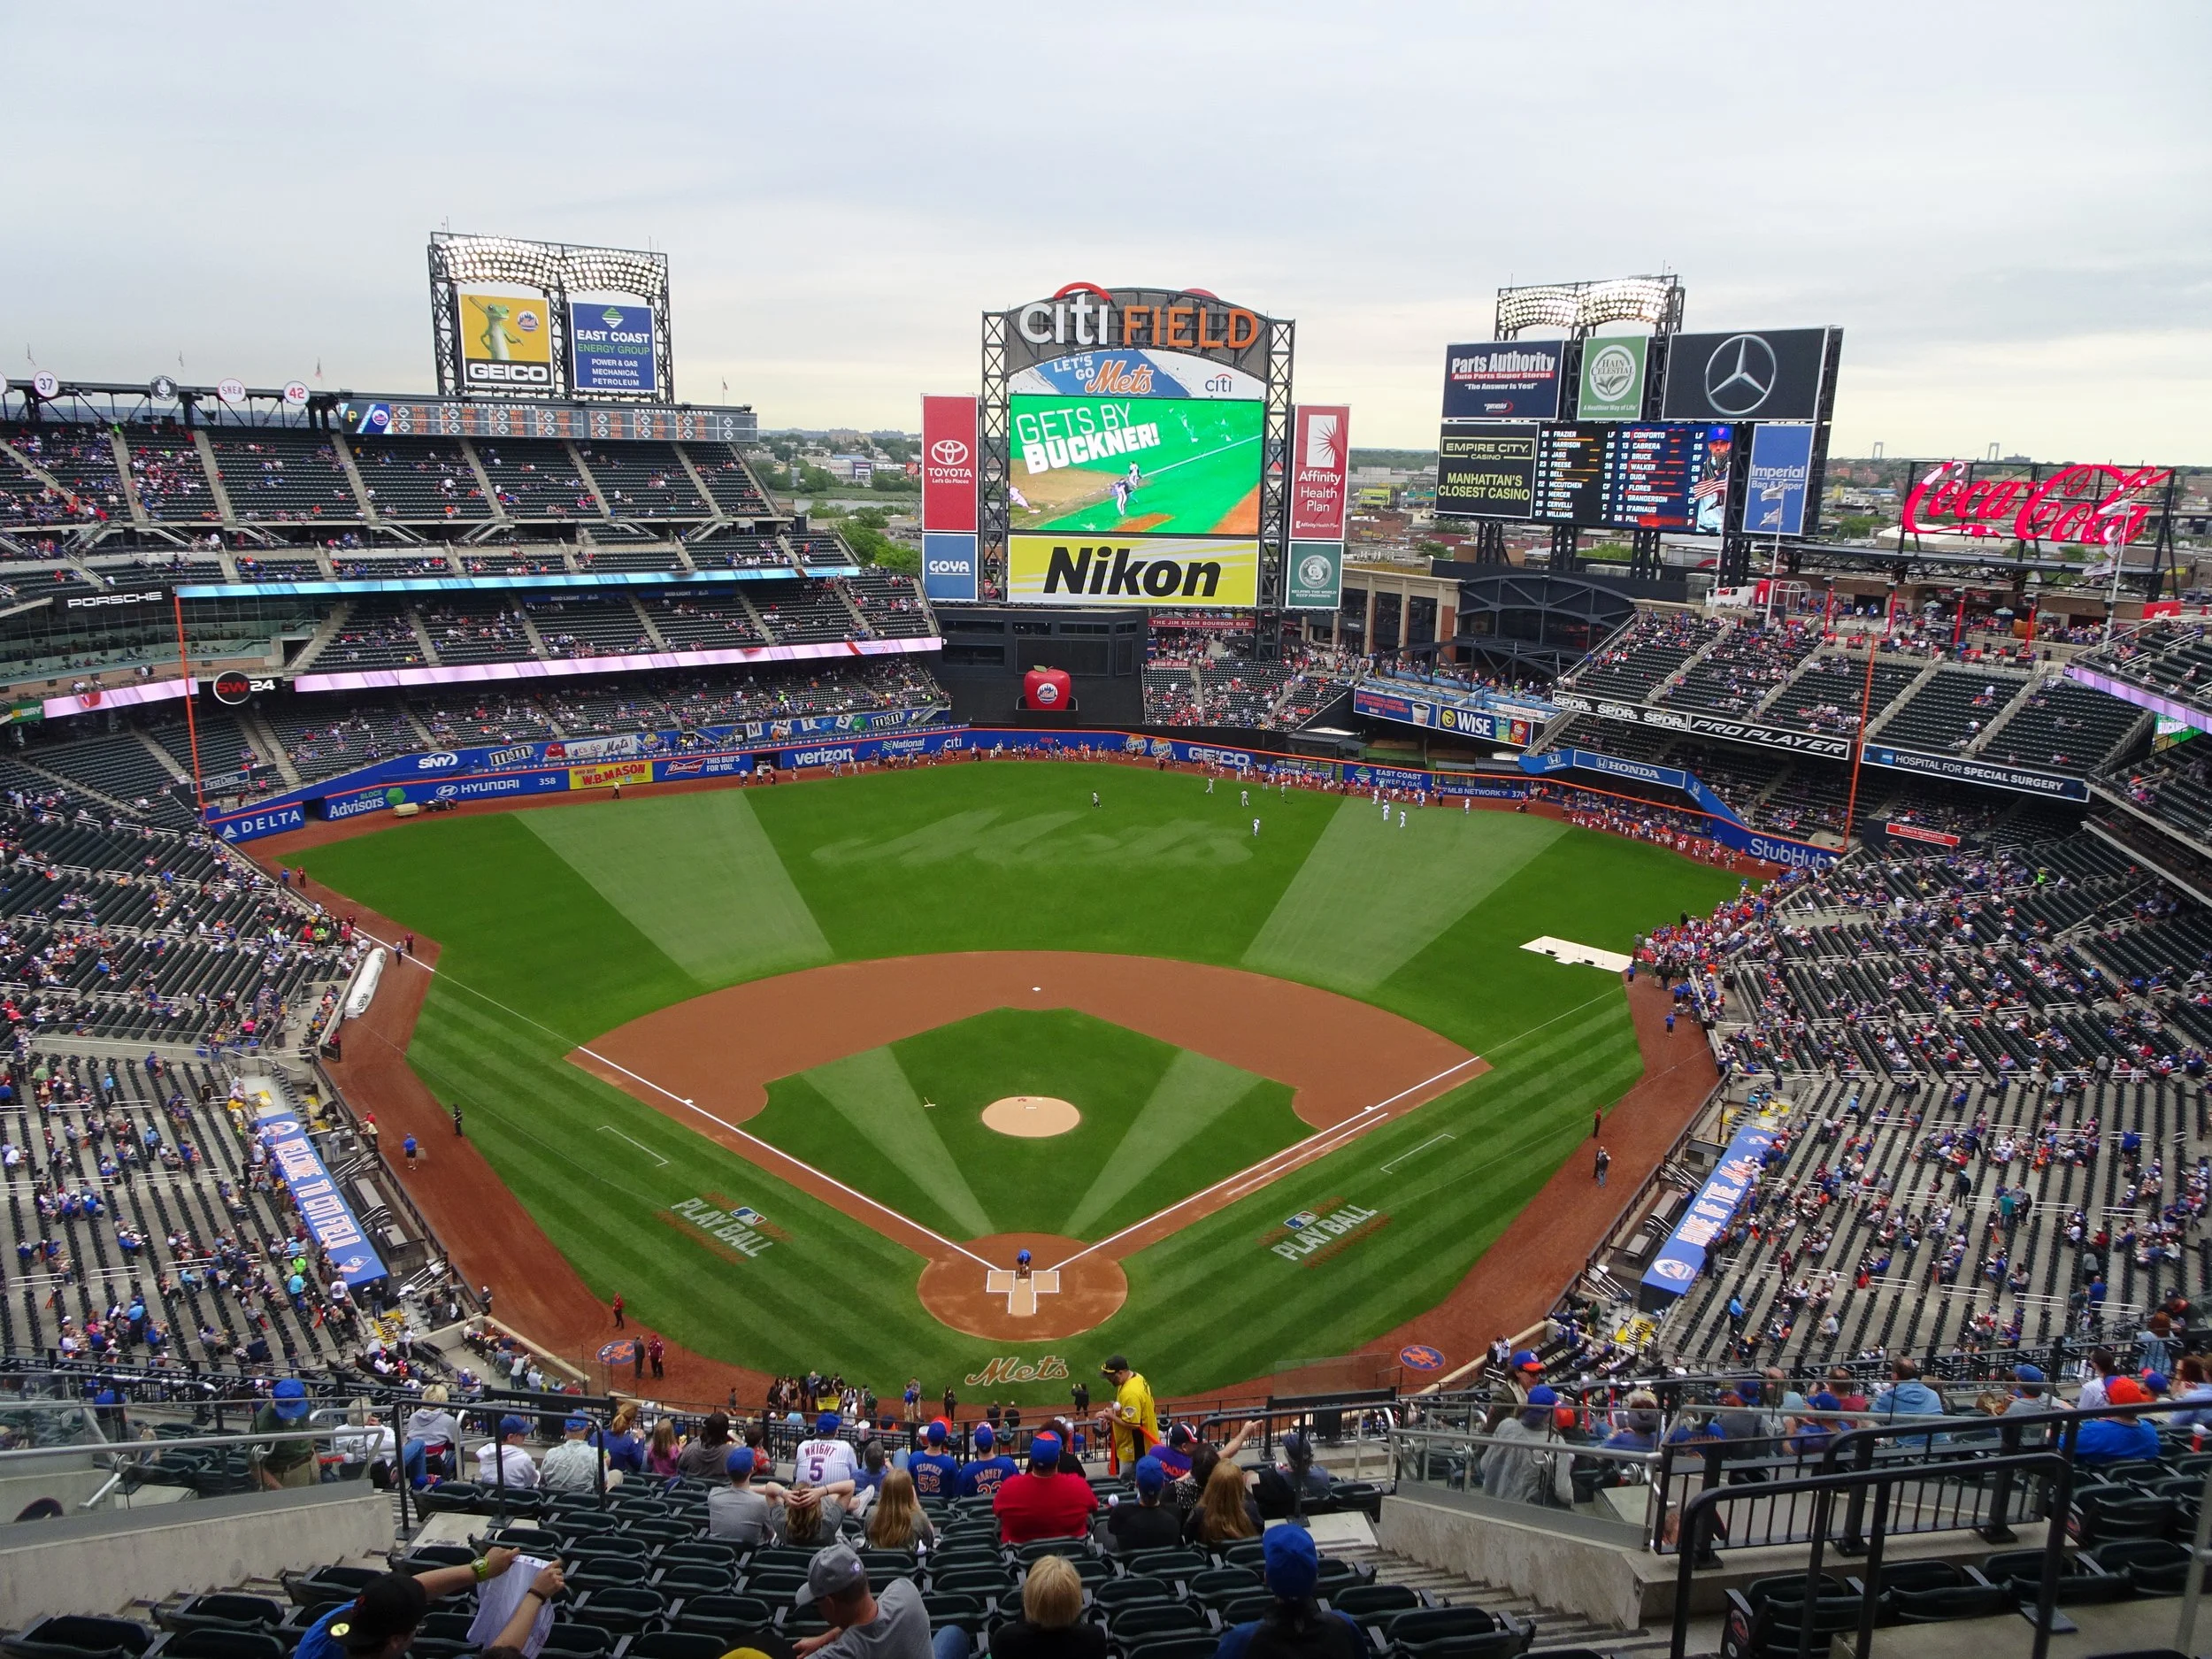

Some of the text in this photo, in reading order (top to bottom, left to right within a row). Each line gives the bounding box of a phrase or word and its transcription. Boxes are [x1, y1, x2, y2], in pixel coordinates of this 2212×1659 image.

[1123, 304, 1258, 349] FIELD
[577, 329, 650, 344] EAST COAST
[578, 343, 650, 355] ENERGY GROUP
[592, 358, 616, 367] POWER
[1053, 354, 1094, 374] LET'S
[1452, 350, 1555, 373] Parts Authority
[470, 364, 548, 381] GEICO
[592, 368, 639, 378] MECHANICAL
[1075, 367, 1095, 381] GO
[1085, 359, 1153, 395] Mets
[1592, 365, 1635, 375] CELESTIAL
[39, 378, 53, 391] 37
[593, 377, 640, 387] PETROLEUM
[222, 386, 243, 396] SHEA
[288, 387, 305, 399] 42
[1016, 403, 1132, 444] GETS BY
[1021, 422, 1159, 475] BUCKNER!
[1446, 442, 1494, 452] EMPIRE
[927, 467, 972, 478] TOYOTA
[1297, 471, 1342, 486] Affinity
[1447, 472, 1523, 487] MANHATTAN'S
[1752, 465, 1805, 480] Imperial
[1751, 480, 1768, 490] Bag
[1300, 486, 1338, 500] Health
[1438, 485, 1531, 501] CLOSEST CASINO
[1307, 500, 1331, 512] Plan
[929, 560, 971, 572] GOYA
[1042, 546, 1222, 597] Nikon
[68, 591, 162, 609] PORSCHE
[218, 679, 276, 694] SW 24
[1515, 707, 1538, 716] PAVILION
[1456, 711, 1492, 735] WISE
[892, 738, 926, 749] National
[1691, 720, 1848, 754] PRO PLAYER
[590, 743, 602, 754] Go
[1126, 741, 1146, 750] Gulf
[1152, 744, 1172, 755] Gulf
[418, 756, 451, 769] SNY
[795, 748, 853, 765] verizon
[1188, 746, 1250, 766] GEICO
[671, 763, 702, 772] Budweiser
[1544, 762, 1567, 771] HONDA
[1608, 761, 1660, 780] HONDA
[1895, 755, 2063, 792] HOSPITAL FOR SPECIAL SURGERY
[204, 775, 238, 788] First Data
[539, 777, 557, 786] 358
[1376, 769, 1422, 780] EAST COAST
[461, 779, 519, 793] HYUNDAI
[1460, 787, 1501, 797] NETWORK
[360, 789, 382, 800] BLOCK
[328, 797, 384, 818] Advisors
[242, 810, 302, 833] DELTA
[1749, 838, 1830, 870] StubHub
[273, 1138, 362, 1249] WELCOME TO CITI FIELD
[1676, 1181, 1741, 1248] HOME THE
[671, 1197, 773, 1257] PLAY BALL
[1271, 1204, 1378, 1261] PLAY BALL
[964, 1355, 1069, 1386] Mets
[804, 1443, 837, 1457] WRIGHT
[809, 1458, 825, 1481] 5
[916, 1463, 943, 1477] CESPEDES
[974, 1468, 1003, 1483] HARVEY
[918, 1475, 941, 1493] 52
